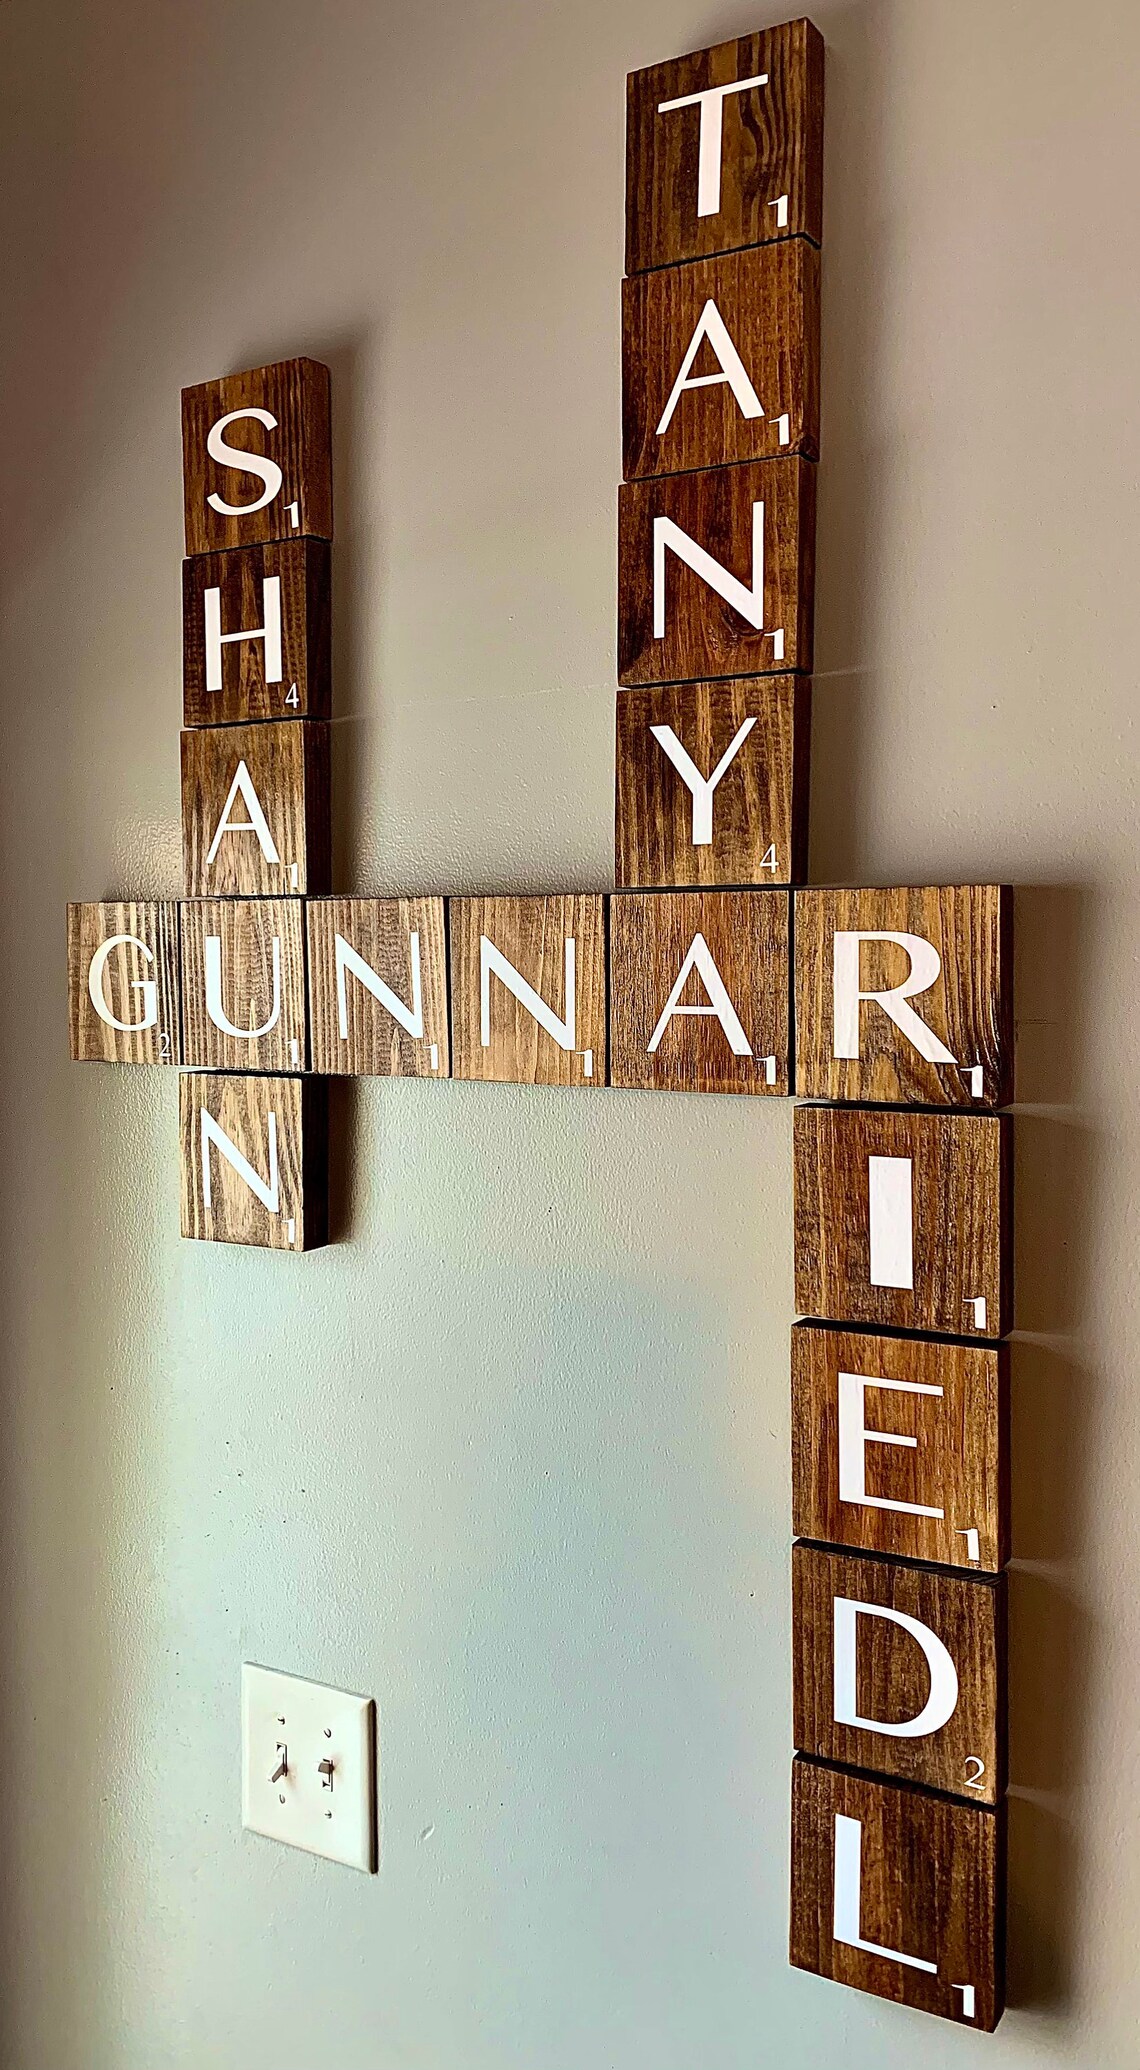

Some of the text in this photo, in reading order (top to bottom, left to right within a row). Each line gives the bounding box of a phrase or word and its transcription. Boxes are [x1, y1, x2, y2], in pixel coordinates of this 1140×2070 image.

[767, 194, 788, 228] 1
[768, 413, 790, 446] 1
[283, 501, 301, 530] 1
[648, 74, 770, 1055] TANYA
[764, 628, 784, 660] 1
[284, 682, 300, 709] 4
[200, 408, 284, 1214] SHAUN
[758, 843, 779, 874] 4
[284, 862, 299, 889] 1
[89, 931, 959, 1064] GUNNAR
[157, 1033, 170, 1060] 2
[288, 1037, 299, 1066] 1
[422, 1042, 438, 1071] 1
[575, 1049, 593, 1078] 1
[755, 1055, 776, 1086] 1
[959, 1065, 984, 1098] 1
[281, 1216, 296, 1244] 1
[962, 1296, 987, 1330] 1
[833, 931, 960, 1974] RIEDL
[955, 1528, 980, 1561] 1
[964, 1756, 986, 1790] 2
[951, 1984, 975, 2018] 1
